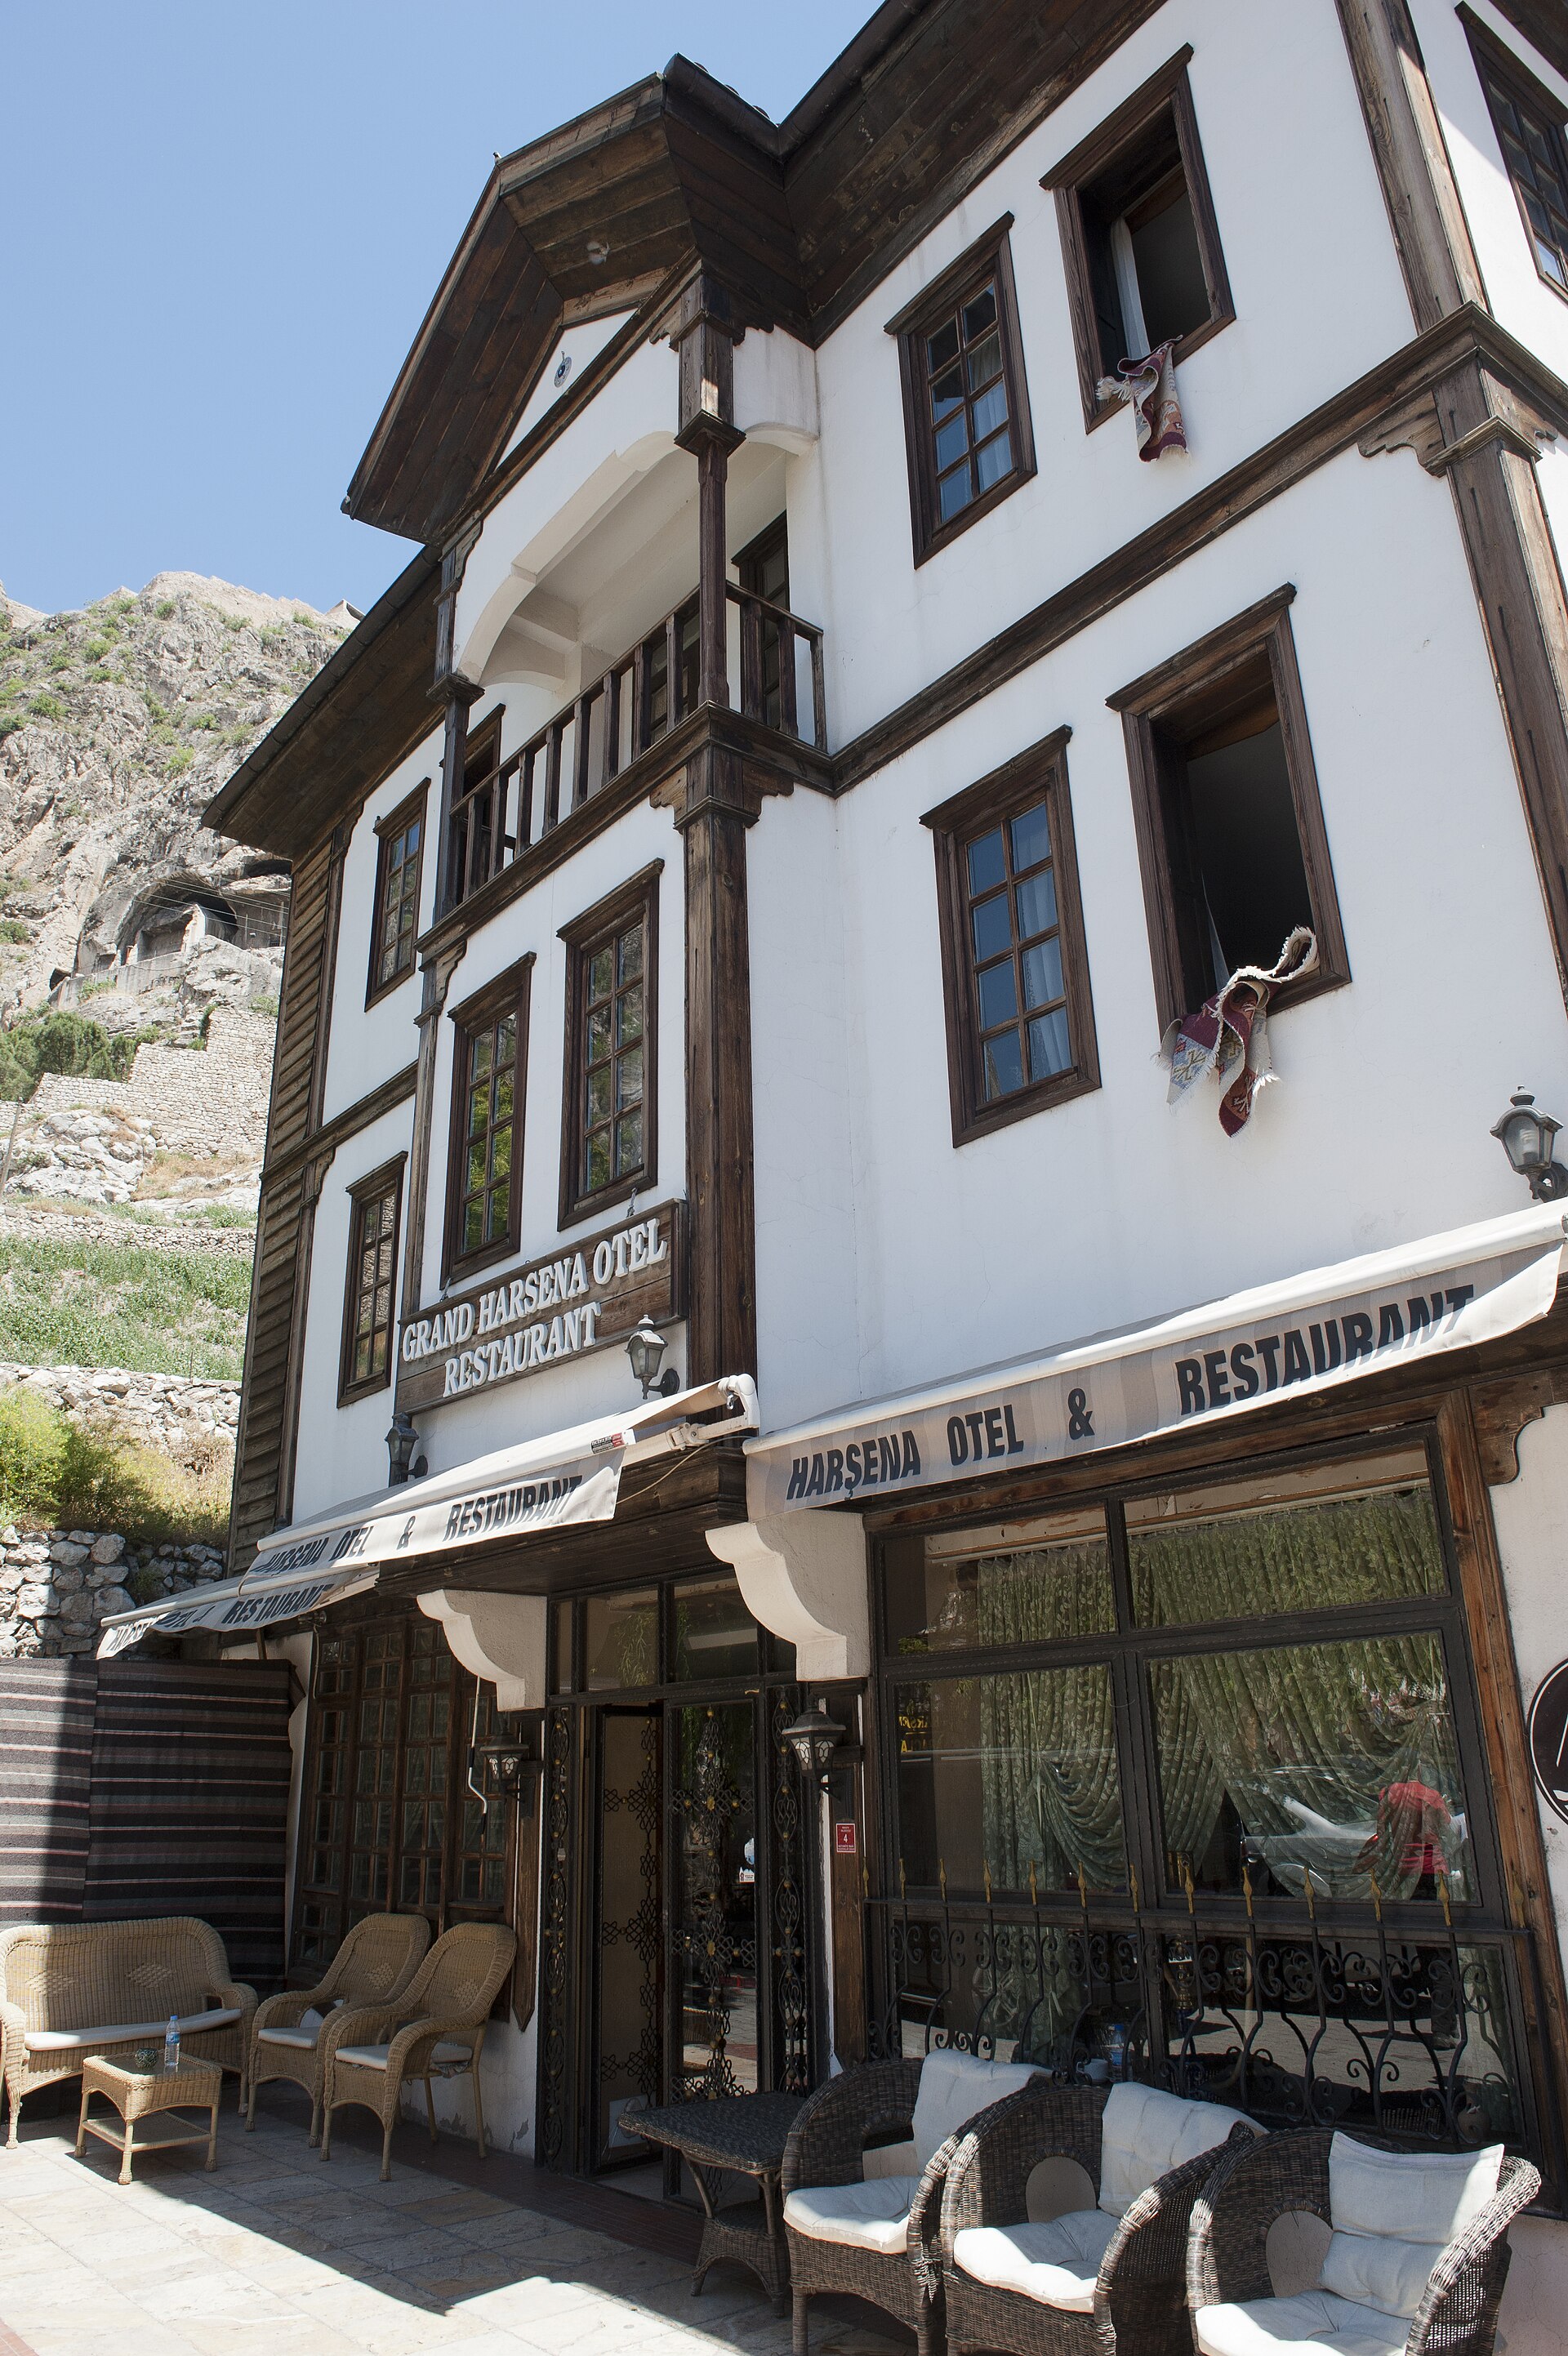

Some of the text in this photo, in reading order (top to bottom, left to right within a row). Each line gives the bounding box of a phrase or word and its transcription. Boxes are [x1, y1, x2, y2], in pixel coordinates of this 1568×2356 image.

[403, 1218, 668, 1362] GRAND HARSENA OTEL
[443, 1301, 602, 1398] RESTAURANT
[786, 1284, 1474, 1501] HARŞENA OTEL & RESTAURANT
[328, 1525, 374, 1562] OTEL
[396, 1515, 416, 1551] &
[442, 1475, 583, 1543] RESTAURANT
[220, 1583, 335, 1625] RESTAURANT
[843, 1833, 849, 1843] 4
